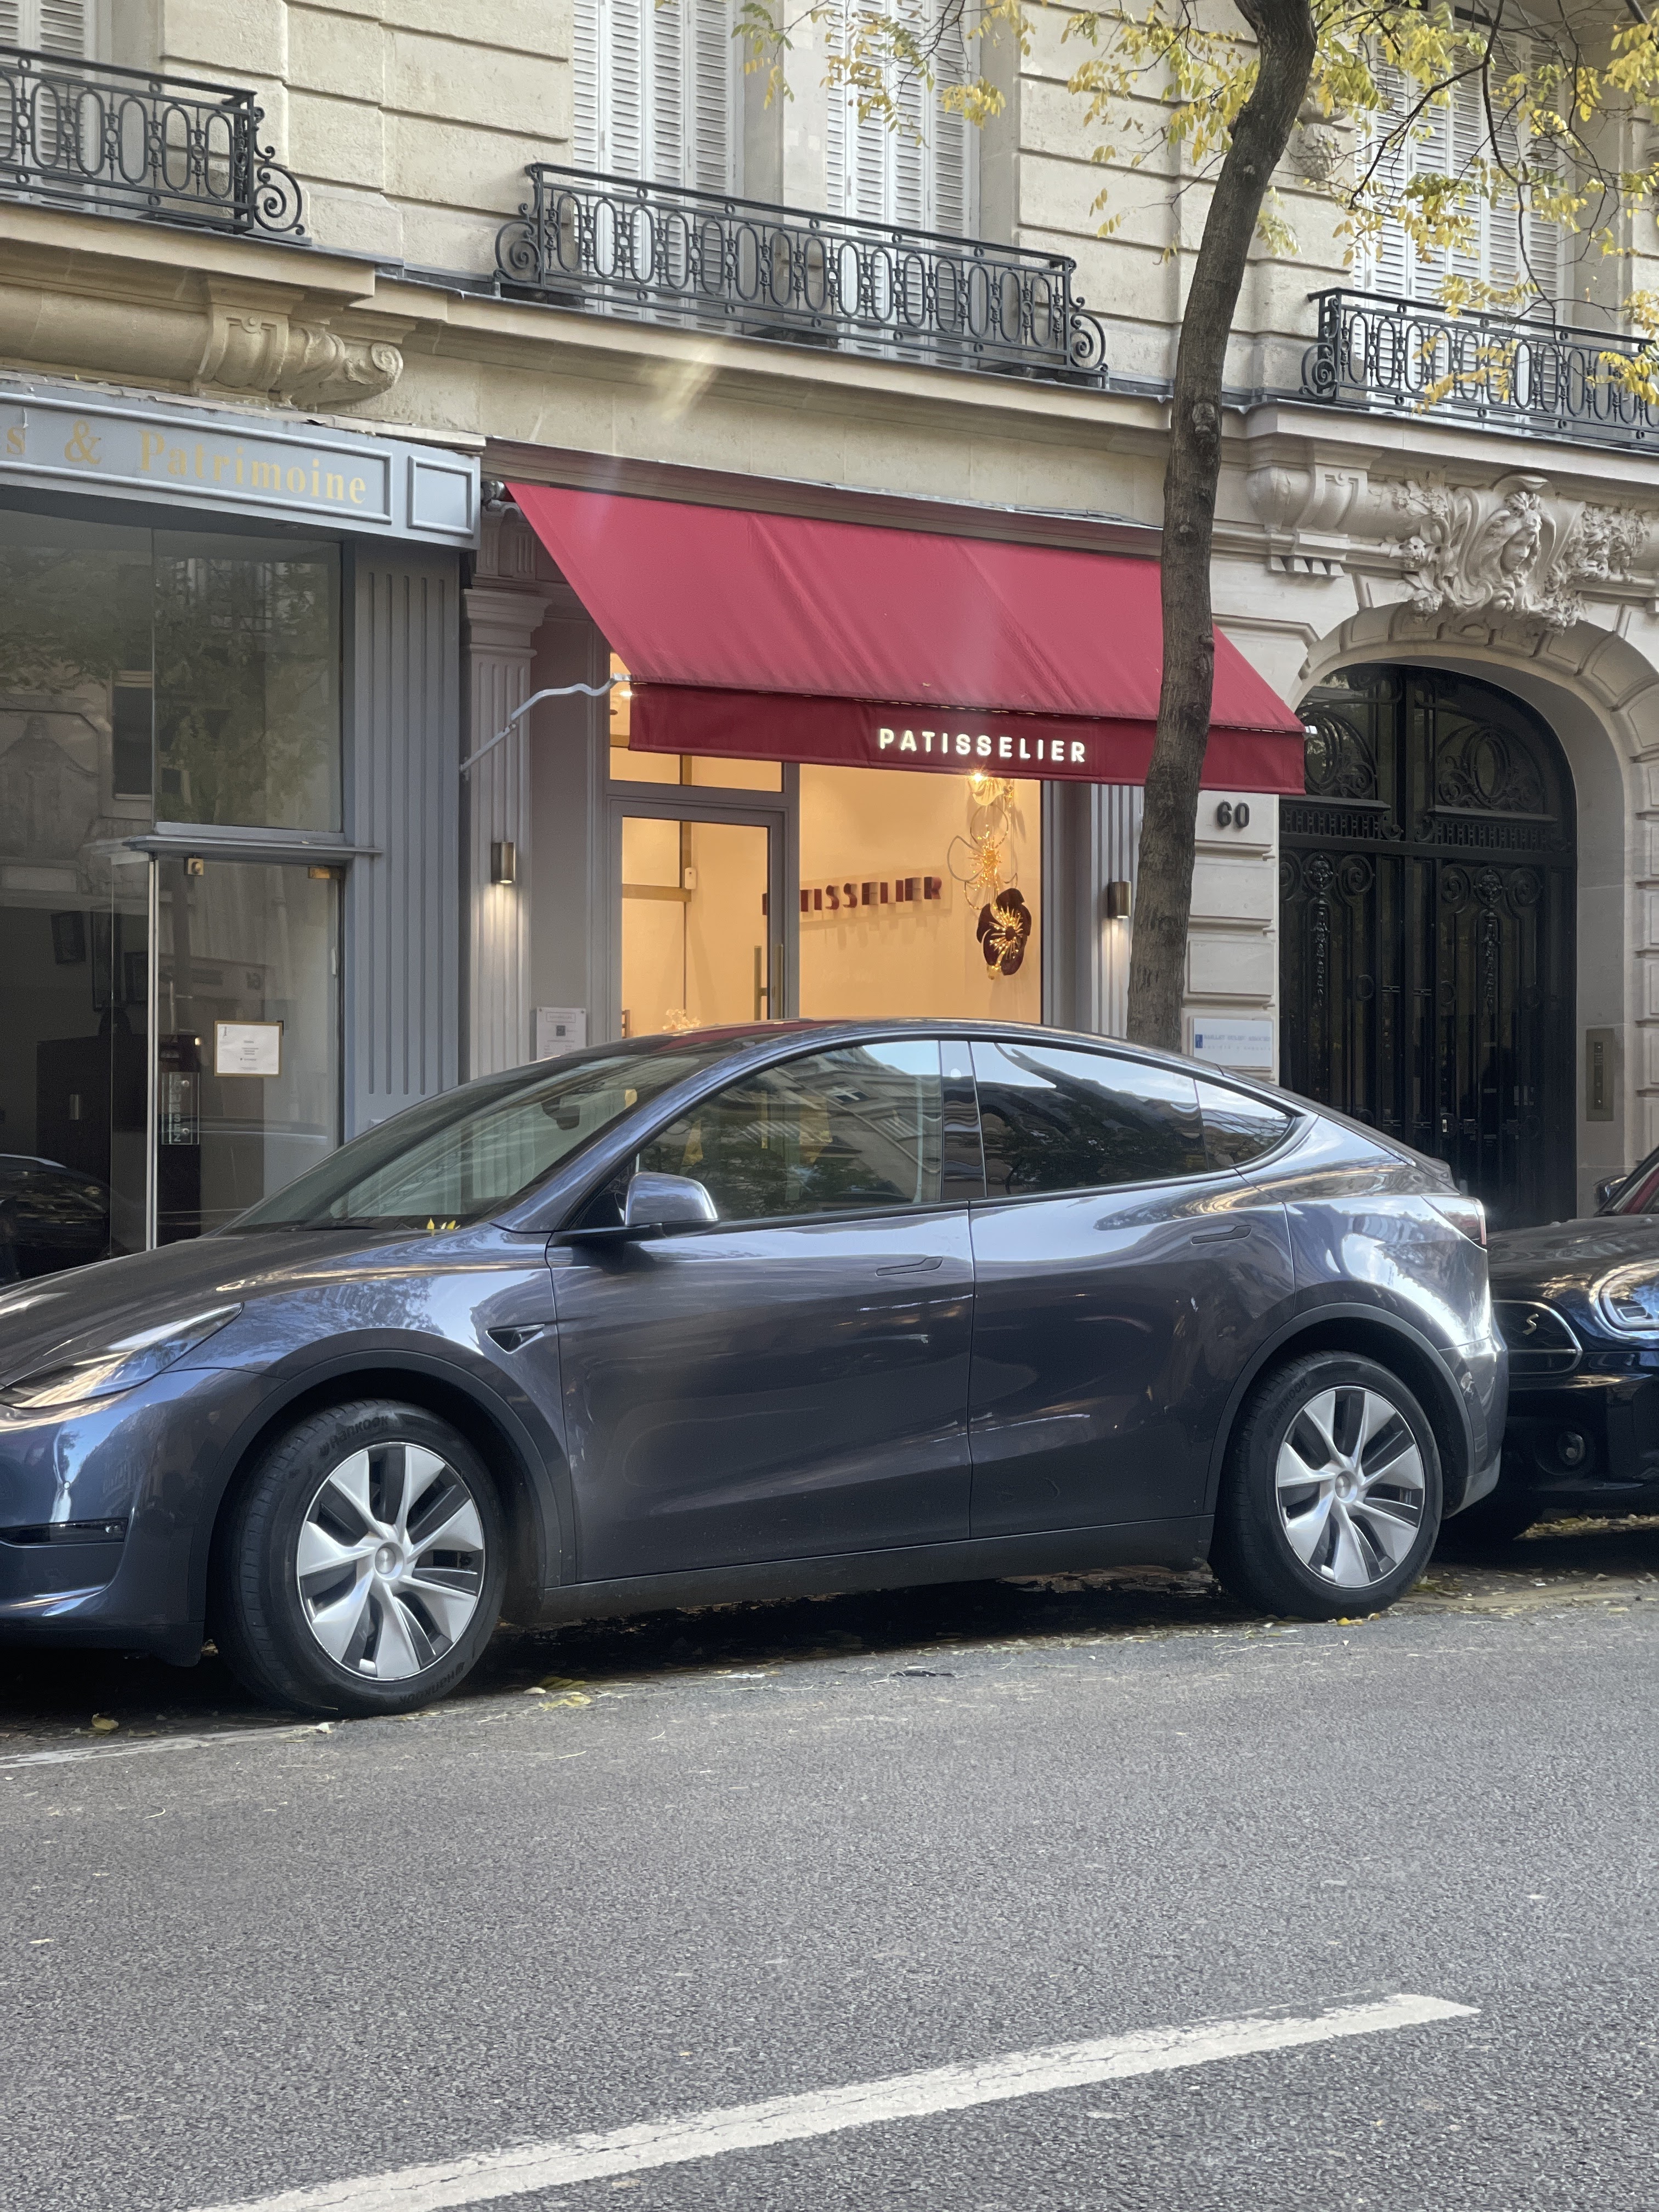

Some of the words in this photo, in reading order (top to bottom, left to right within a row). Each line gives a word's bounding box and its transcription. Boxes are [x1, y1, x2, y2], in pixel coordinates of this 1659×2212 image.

[64, 419, 103, 465] &
[137, 429, 366, 505] Patrimoine
[879, 727, 1086, 763] PATISSELIER
[1217, 801, 1250, 828] 60
[762, 876, 942, 916] TISSELIER
